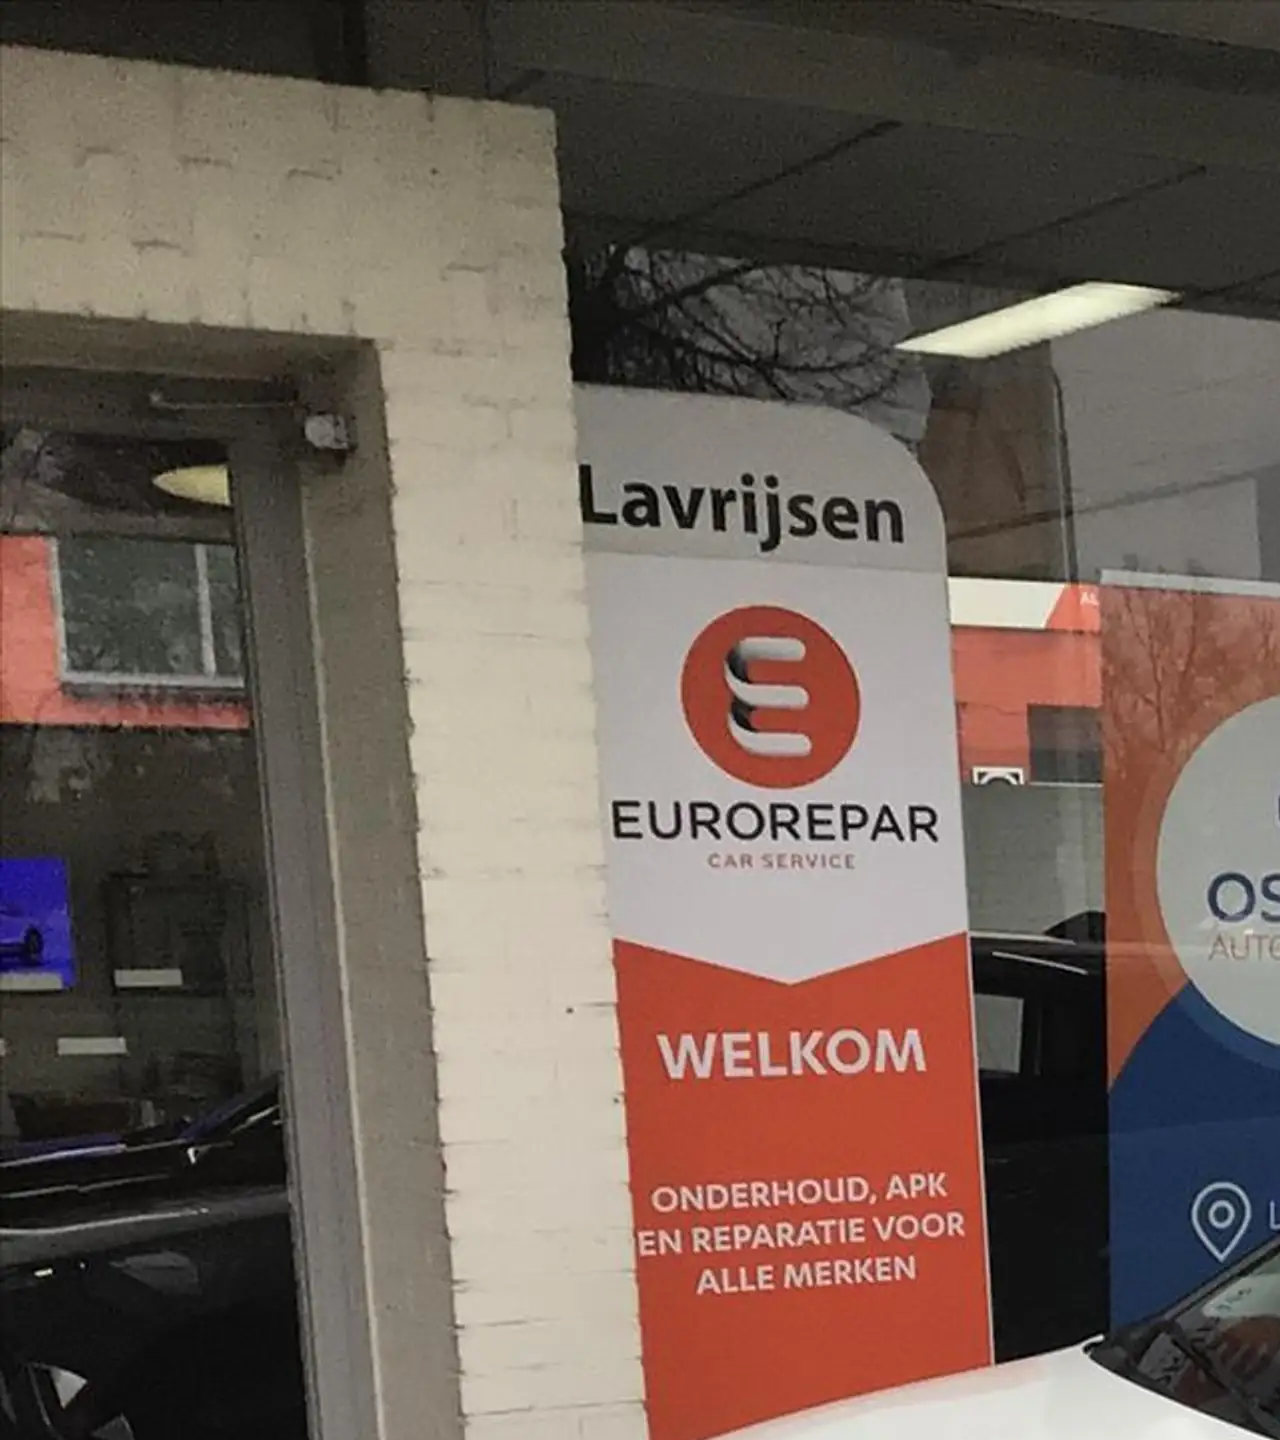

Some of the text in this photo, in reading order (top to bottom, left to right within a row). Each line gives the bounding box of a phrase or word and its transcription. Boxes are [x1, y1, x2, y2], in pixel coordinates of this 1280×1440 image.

[577, 464, 905, 552] Lavrijsen
[611, 799, 940, 843] EUROREPAR
[707, 852, 856, 870] CAR SERVICE
[656, 1028, 927, 1080] WELKOM
[651, 1172, 948, 1213] ONDERHOUD, APK
[638, 1212, 966, 1257] EN REPARATIE VOOR
[696, 1255, 917, 1295] ALLE MERKEN
